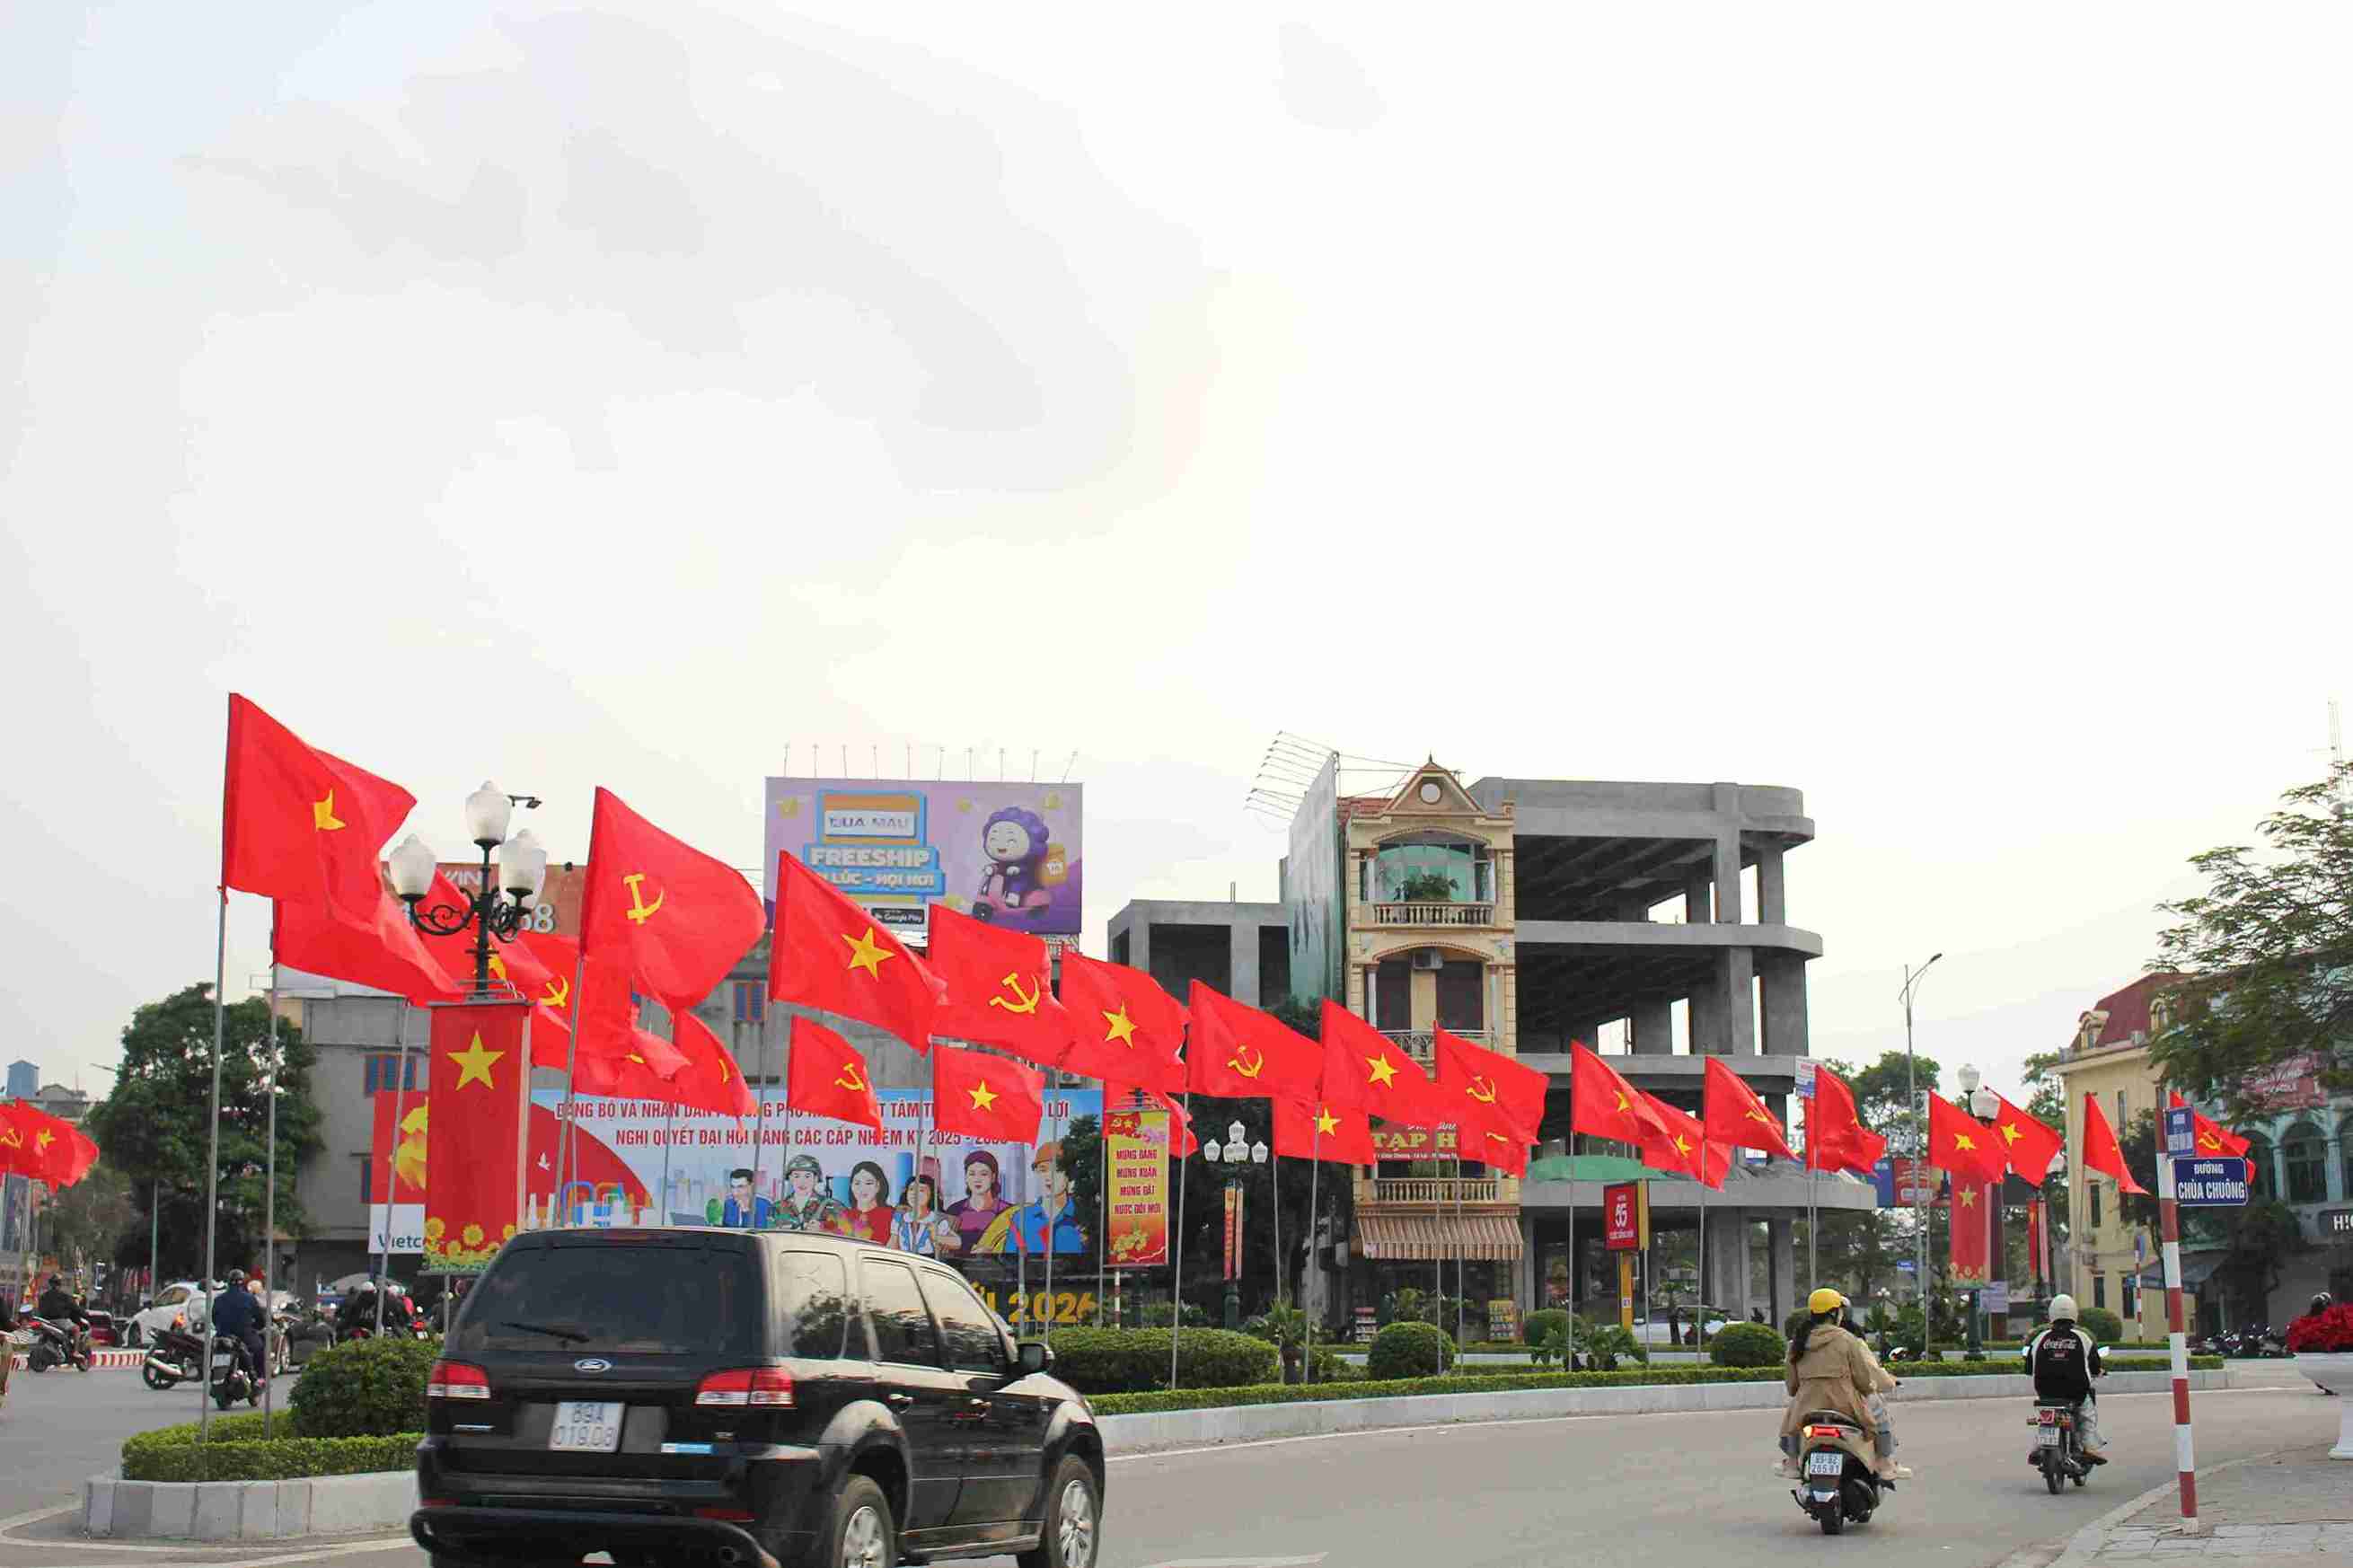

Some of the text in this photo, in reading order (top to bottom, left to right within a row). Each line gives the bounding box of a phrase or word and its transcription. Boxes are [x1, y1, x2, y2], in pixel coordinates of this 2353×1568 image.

[811, 847, 930, 868] FREESHIP
[928, 1130, 961, 1146] 2025
[2194, 1160, 2225, 1175] ĐƯỜNG
[2178, 1178, 2245, 1200] CHÙA CHUÔNG
[378, 1234, 427, 1248] Vietc
